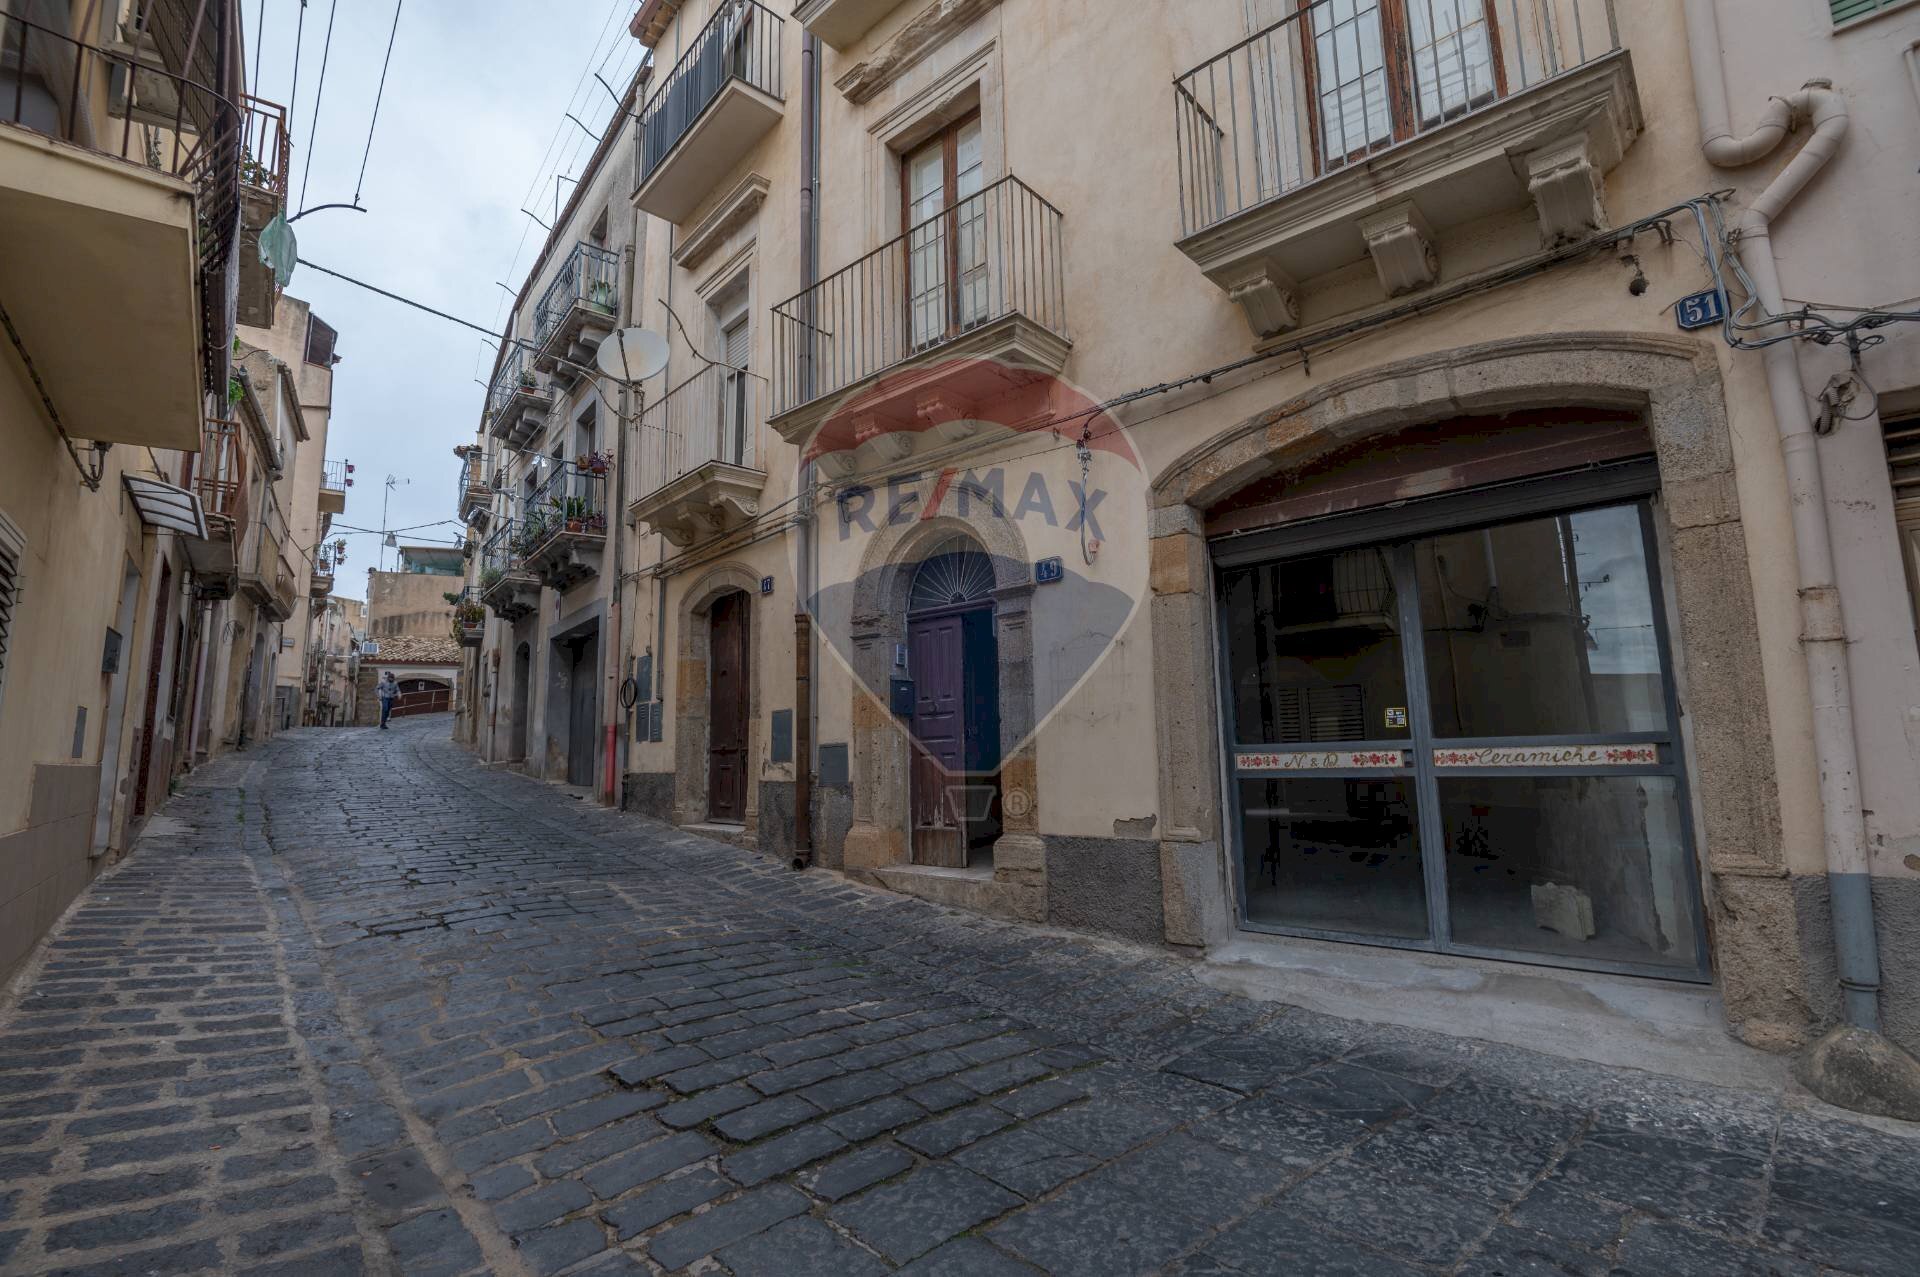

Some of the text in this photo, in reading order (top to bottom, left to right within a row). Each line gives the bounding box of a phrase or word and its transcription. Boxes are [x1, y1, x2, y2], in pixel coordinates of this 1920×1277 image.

[1685, 293, 1719, 322] 51
[1040, 560, 1057, 579] 49
[1310, 757, 1319, 767] &
[1475, 746, 1601, 765] Ceramiche
